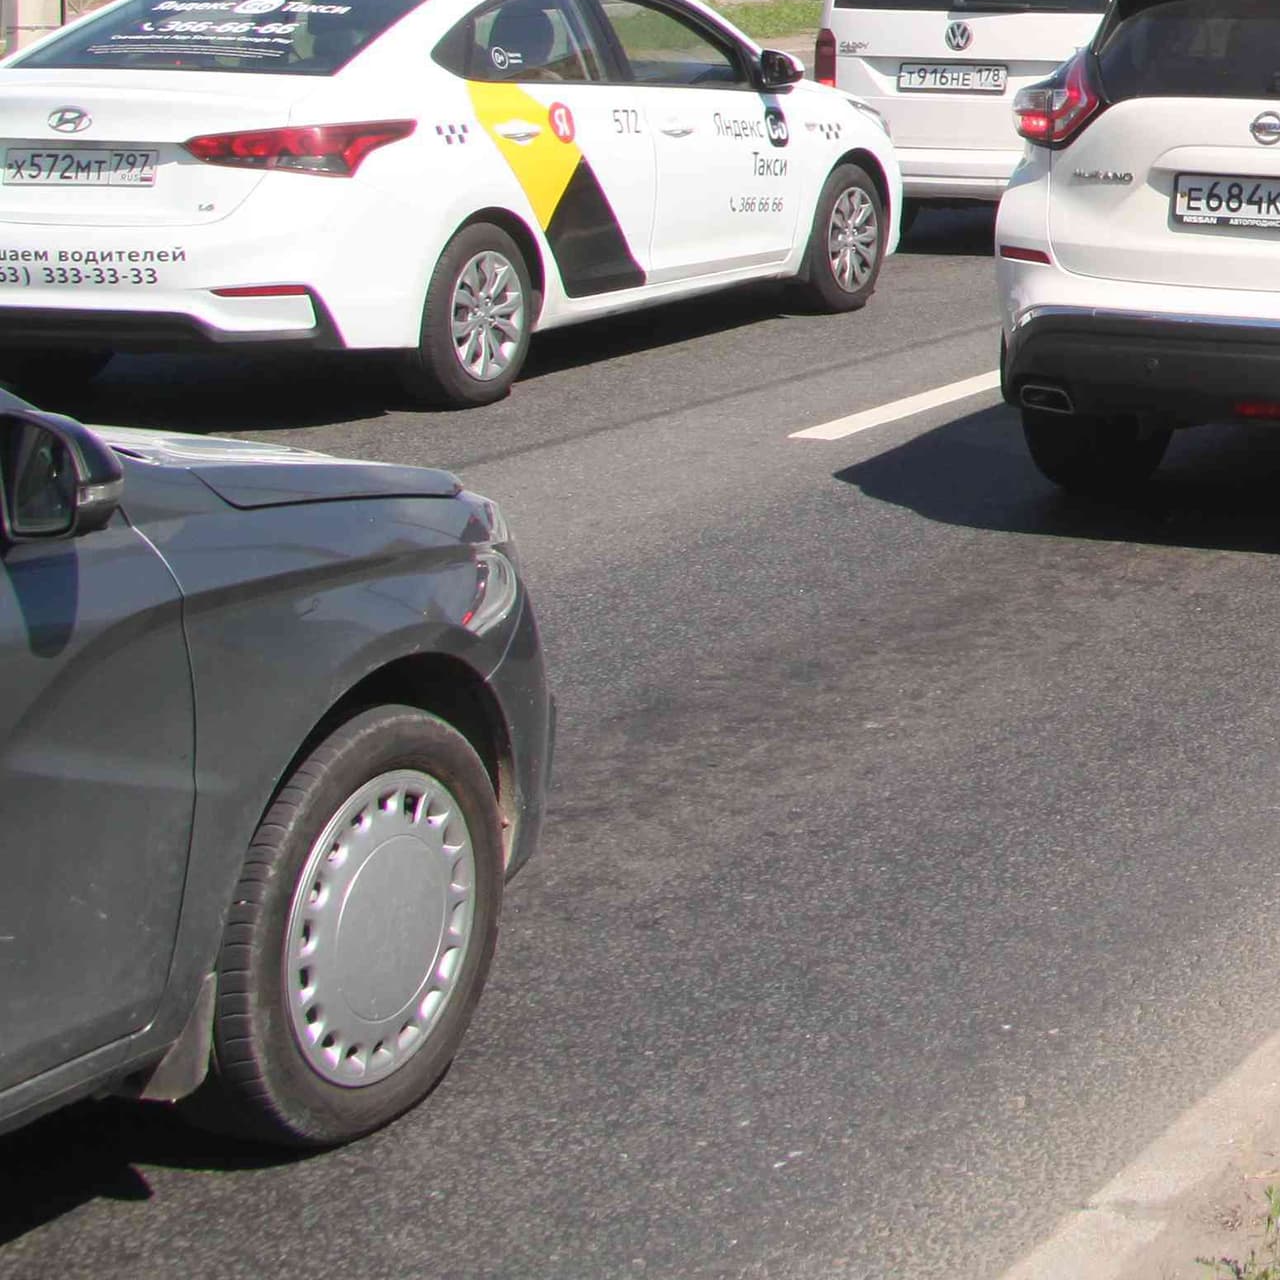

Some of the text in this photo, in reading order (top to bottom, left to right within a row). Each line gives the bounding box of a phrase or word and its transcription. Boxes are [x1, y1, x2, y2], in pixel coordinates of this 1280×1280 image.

[151, 0, 238, 12] Яндекс
[281, 1, 352, 15] Такси
[159, 20, 297, 34] 366-66-66
[976, 68, 1001, 83] 178
[612, 108, 643, 135] 572
[713, 112, 765, 141] Яндекс
[112, 153, 150, 174] 797
[752, 151, 788, 177] Такси
[120, 174, 141, 183] RUS
[738, 196, 784, 213] 366 66 66
[1183, 216, 1218, 225] NISSAN
[58, 247, 187, 263] водителей
[42, 267, 158, 285] 333-33-33
